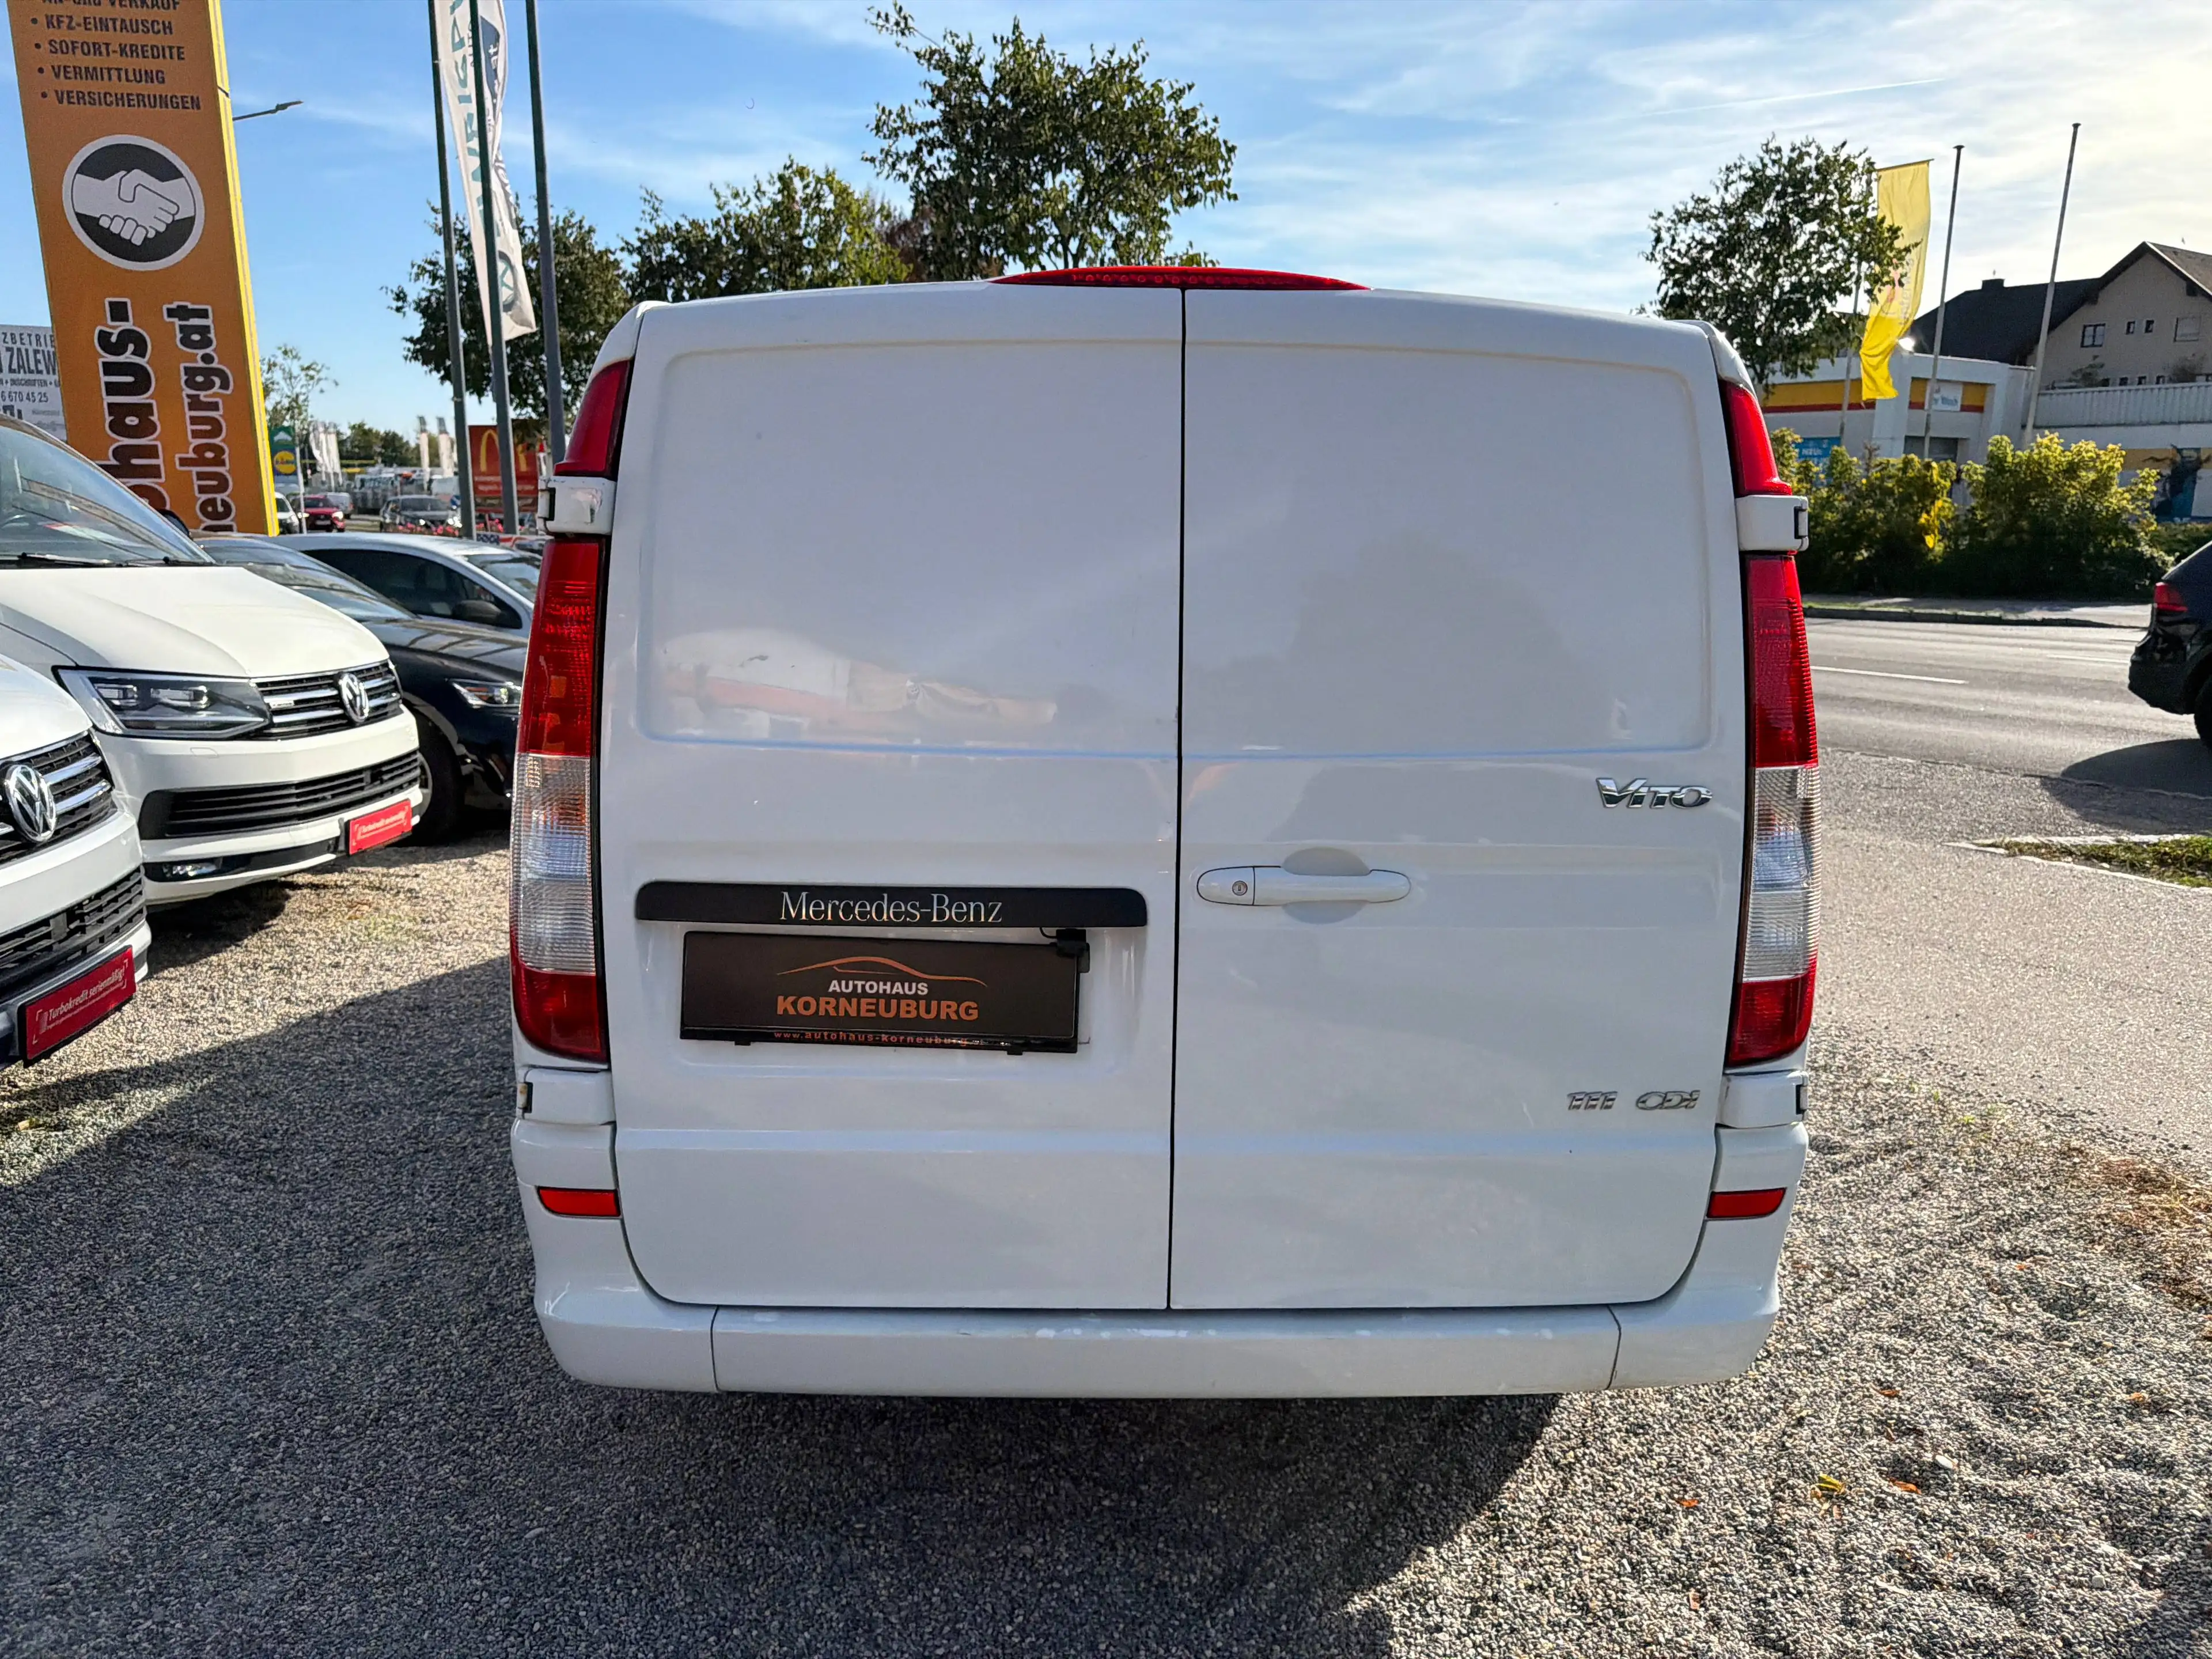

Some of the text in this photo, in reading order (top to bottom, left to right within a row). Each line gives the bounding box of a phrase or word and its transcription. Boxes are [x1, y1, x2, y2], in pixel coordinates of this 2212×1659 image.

[45, 14, 173, 35] KFZ-EINTAUSCH
[48, 39, 185, 60] SOFORT-KREDITE
[51, 65, 165, 84] VERMITTLUNG
[54, 89, 201, 110] VERSICHERUNGEN
[780, 891, 1003, 923] Mercedes-Benz
[828, 979, 929, 995] AUTOHAUS
[49, 989, 89, 1021] Turbokredit
[776, 995, 979, 1021] KORNEUBURG
